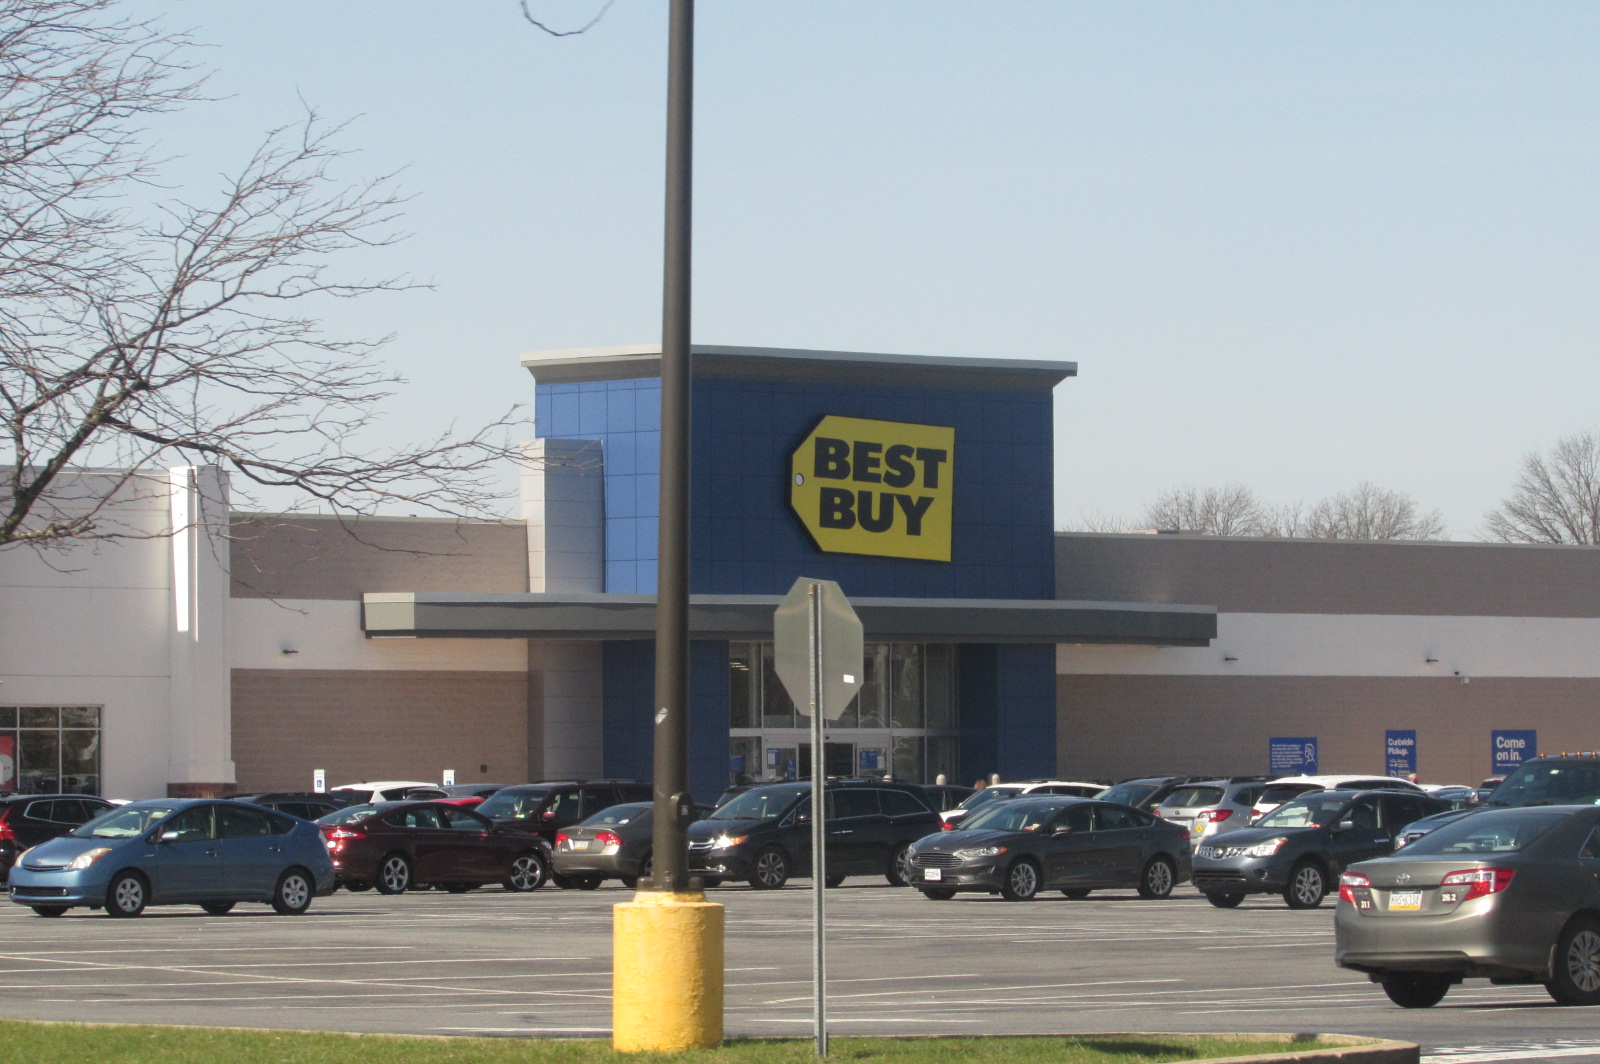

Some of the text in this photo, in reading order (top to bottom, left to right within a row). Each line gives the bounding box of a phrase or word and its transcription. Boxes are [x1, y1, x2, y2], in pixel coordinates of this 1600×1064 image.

[813, 436, 948, 489] BEST
[819, 486, 936, 537] BUY
[1387, 737, 1414, 746] Curbside
[1496, 736, 1525, 748] Come
[1496, 751, 1509, 761] on
[1442, 893, 1456, 902] 26.2
